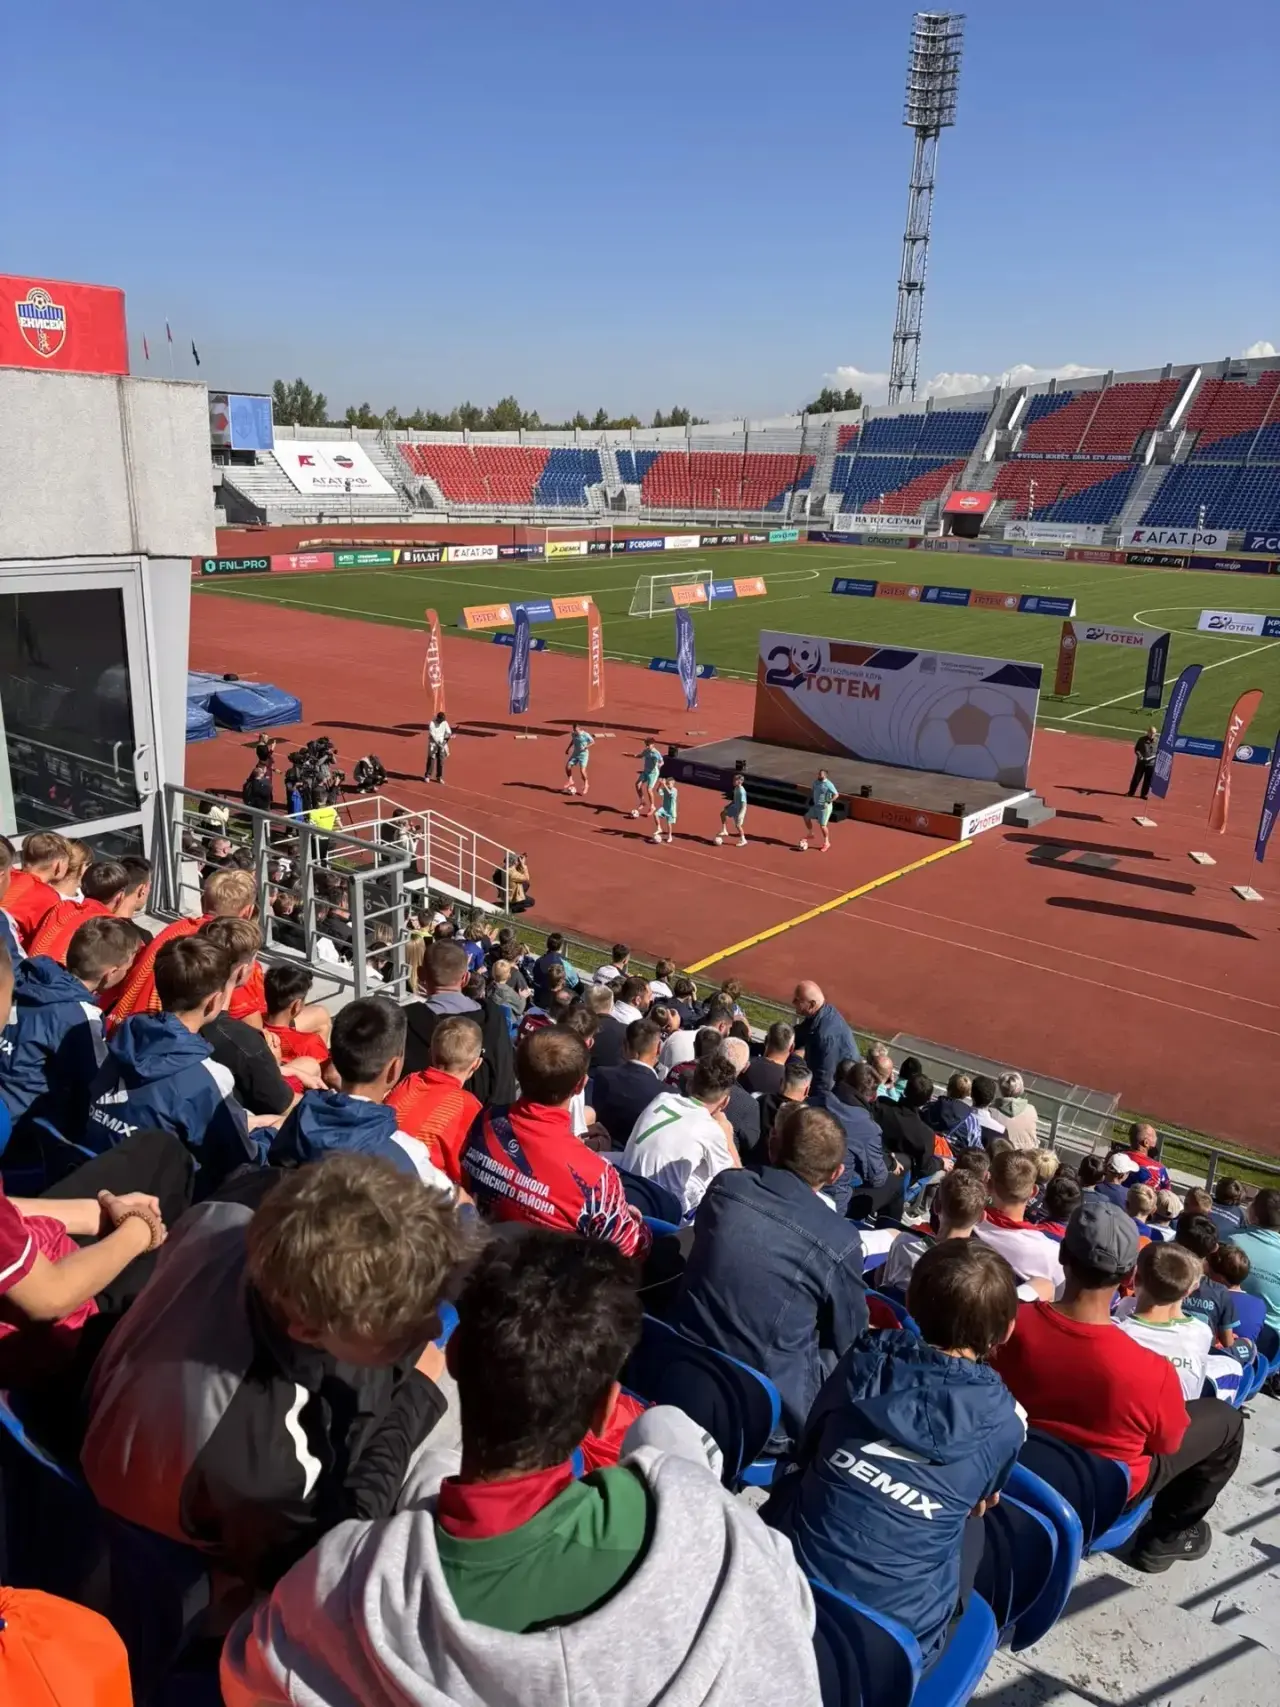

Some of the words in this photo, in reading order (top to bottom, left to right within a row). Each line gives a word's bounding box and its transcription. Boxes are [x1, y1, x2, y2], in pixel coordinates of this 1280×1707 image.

[19, 316, 65, 332] ЕНИСЕЙ
[312, 477, 368, 485] АГАТРФ
[1146, 531, 1218, 545] АГАТ.РФ
[806, 674, 881, 701] ТОТЕМ
[88, 1104, 139, 1138] DEMIX
[633, 1104, 683, 1145] 7
[514, 1172, 551, 1198] ШКОЛА
[516, 1189, 556, 1216] РАЙОНА
[828, 1447, 944, 1520] DEMIX
